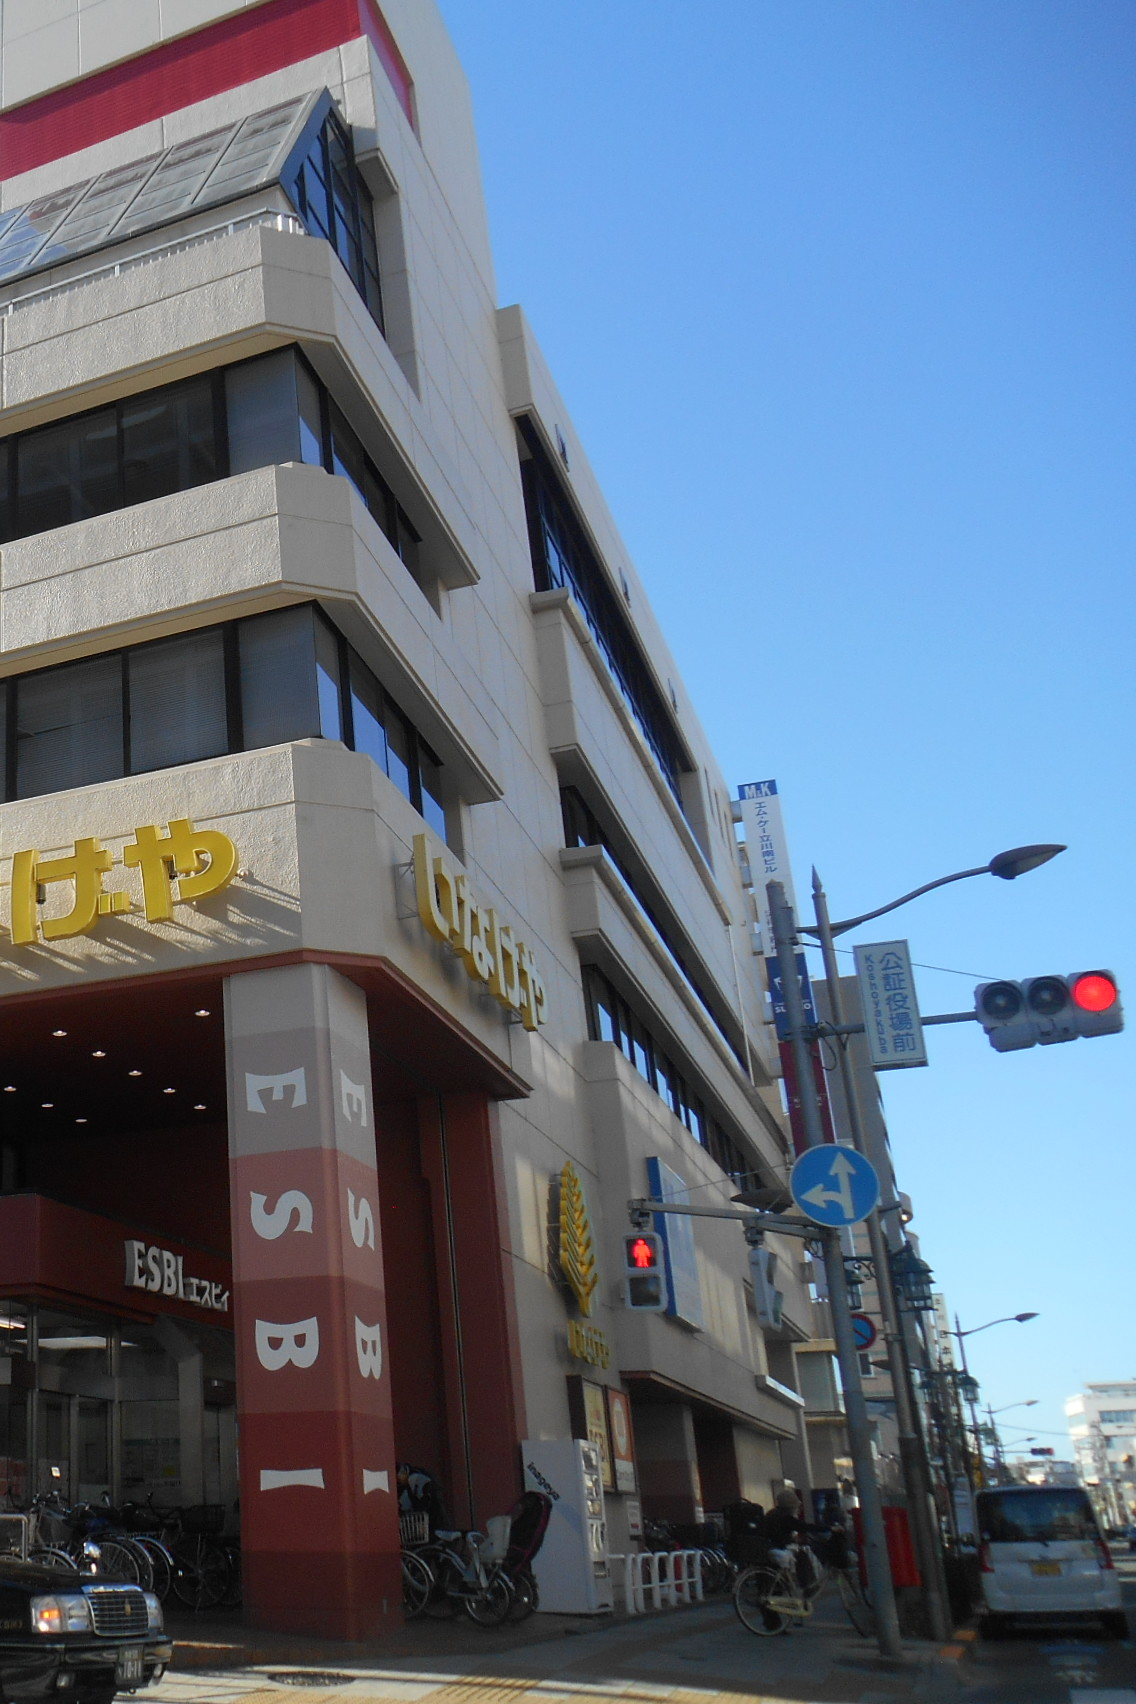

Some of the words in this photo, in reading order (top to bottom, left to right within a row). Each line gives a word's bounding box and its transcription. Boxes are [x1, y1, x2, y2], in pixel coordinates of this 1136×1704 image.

[413, 833, 549, 1032] いなげや
[864, 954, 888, 1054] Koshoyakuba
[880, 952, 916, 1053] 公証役場前
[125, 1240, 184, 1299] ESBI
[245, 1067, 325, 1491] ESBI
[339, 1069, 390, 1494] ESBI
[526, 1461, 561, 1501] inageya
